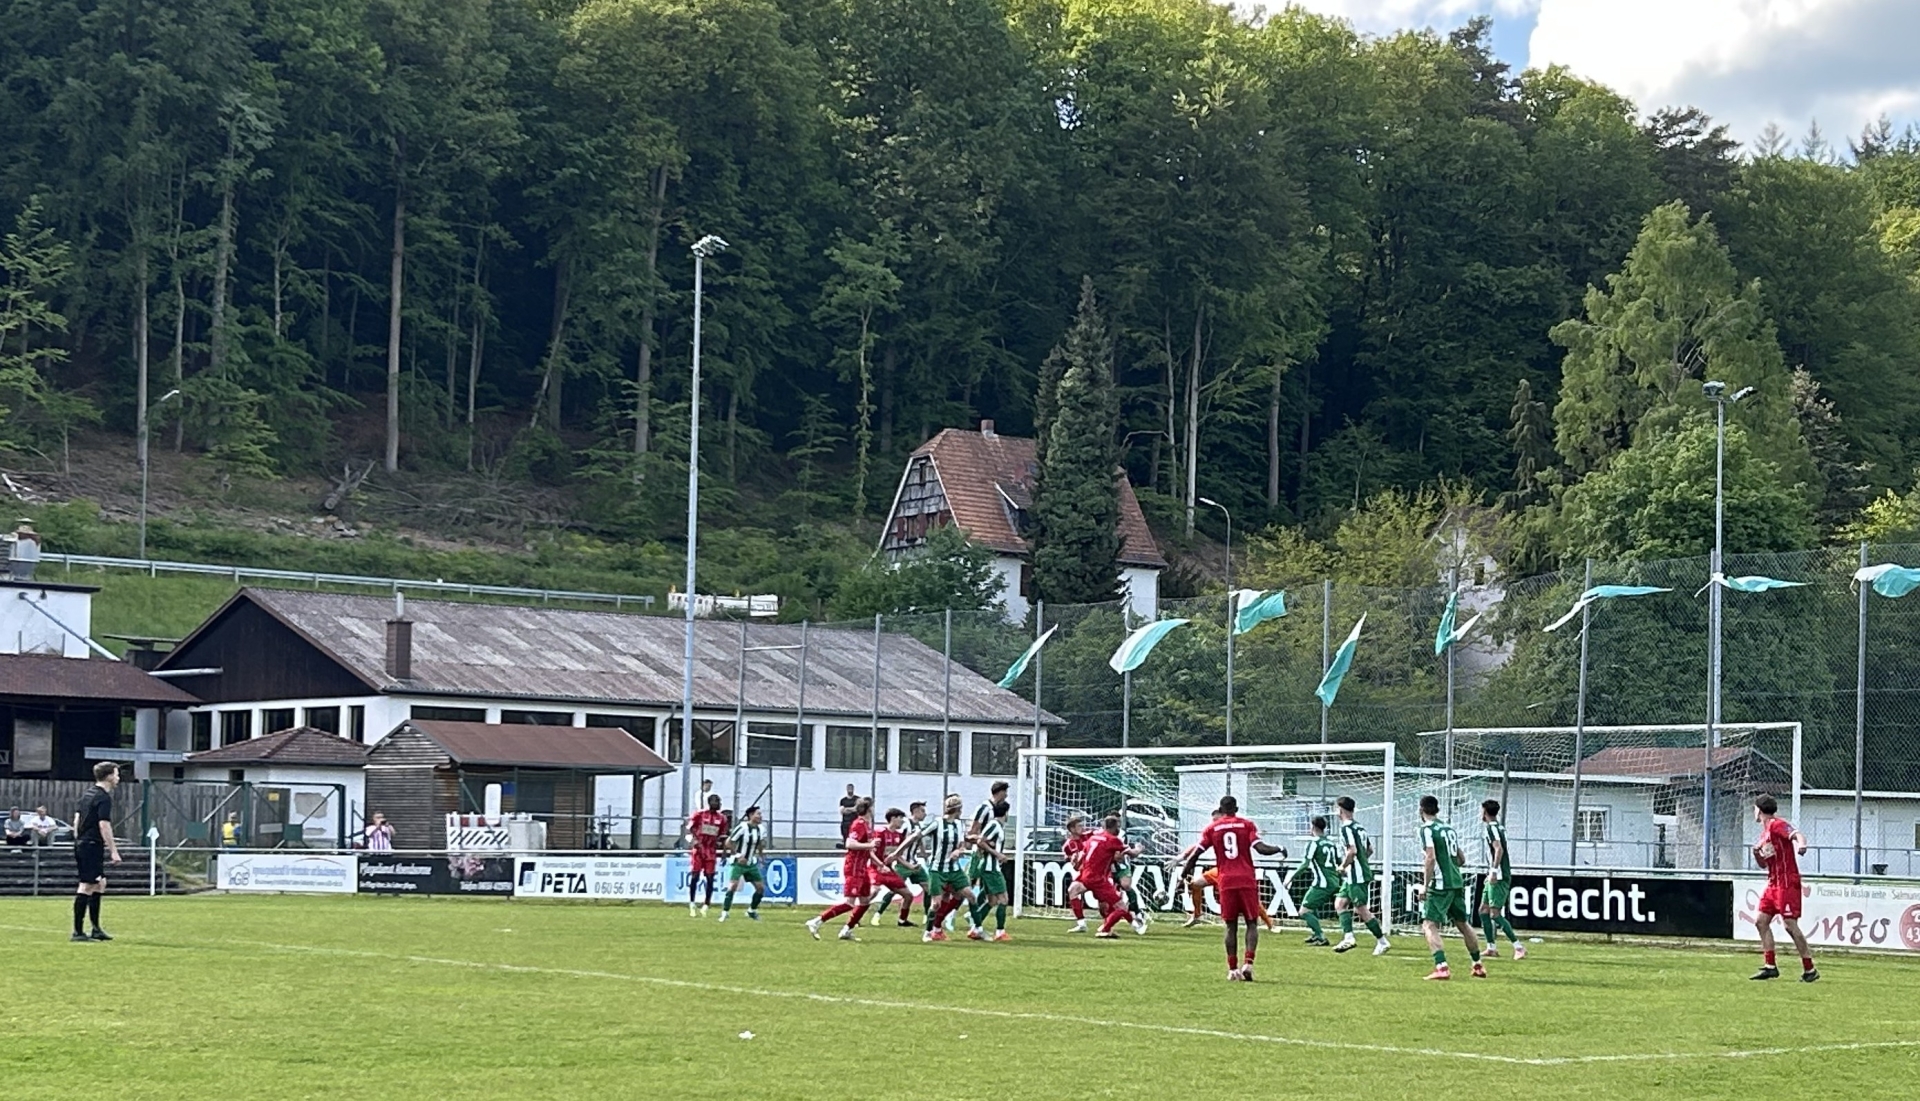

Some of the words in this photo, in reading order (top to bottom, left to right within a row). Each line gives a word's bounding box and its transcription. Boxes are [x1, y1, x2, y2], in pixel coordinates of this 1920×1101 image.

[1085, 840, 1099, 861] 7
[1223, 831, 1239, 861] 9
[1440, 829, 1458, 857] 18
[540, 872, 588, 893] PETA
[1500, 876, 1656, 923] edacht.
